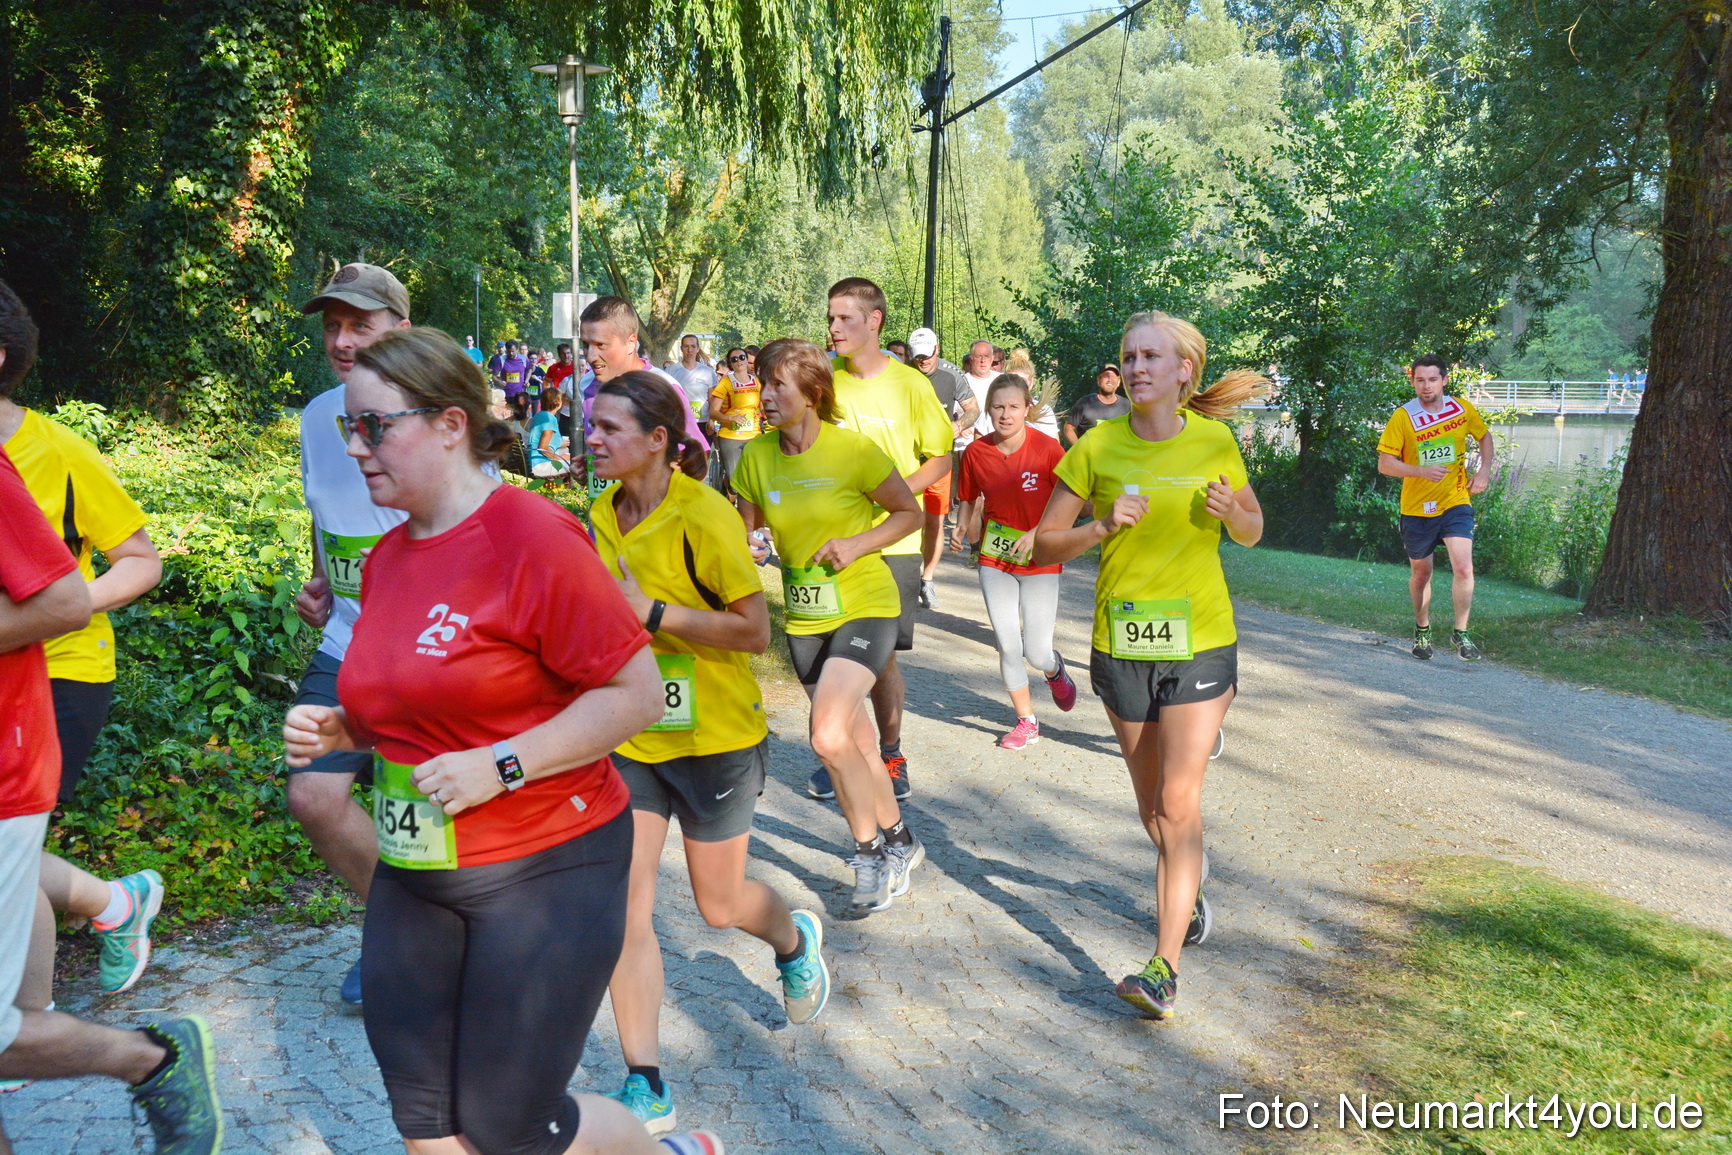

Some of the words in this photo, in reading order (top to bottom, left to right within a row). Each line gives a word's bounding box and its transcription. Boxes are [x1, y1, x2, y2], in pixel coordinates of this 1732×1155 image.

[1416, 428, 1441, 442] MAX
[1422, 446, 1452, 460] 1232
[1021, 471, 1039, 488] 25
[789, 585, 821, 604] 937
[415, 603, 469, 647] 25
[1126, 622, 1172, 643] 944
[400, 841, 429, 853] Jenny
